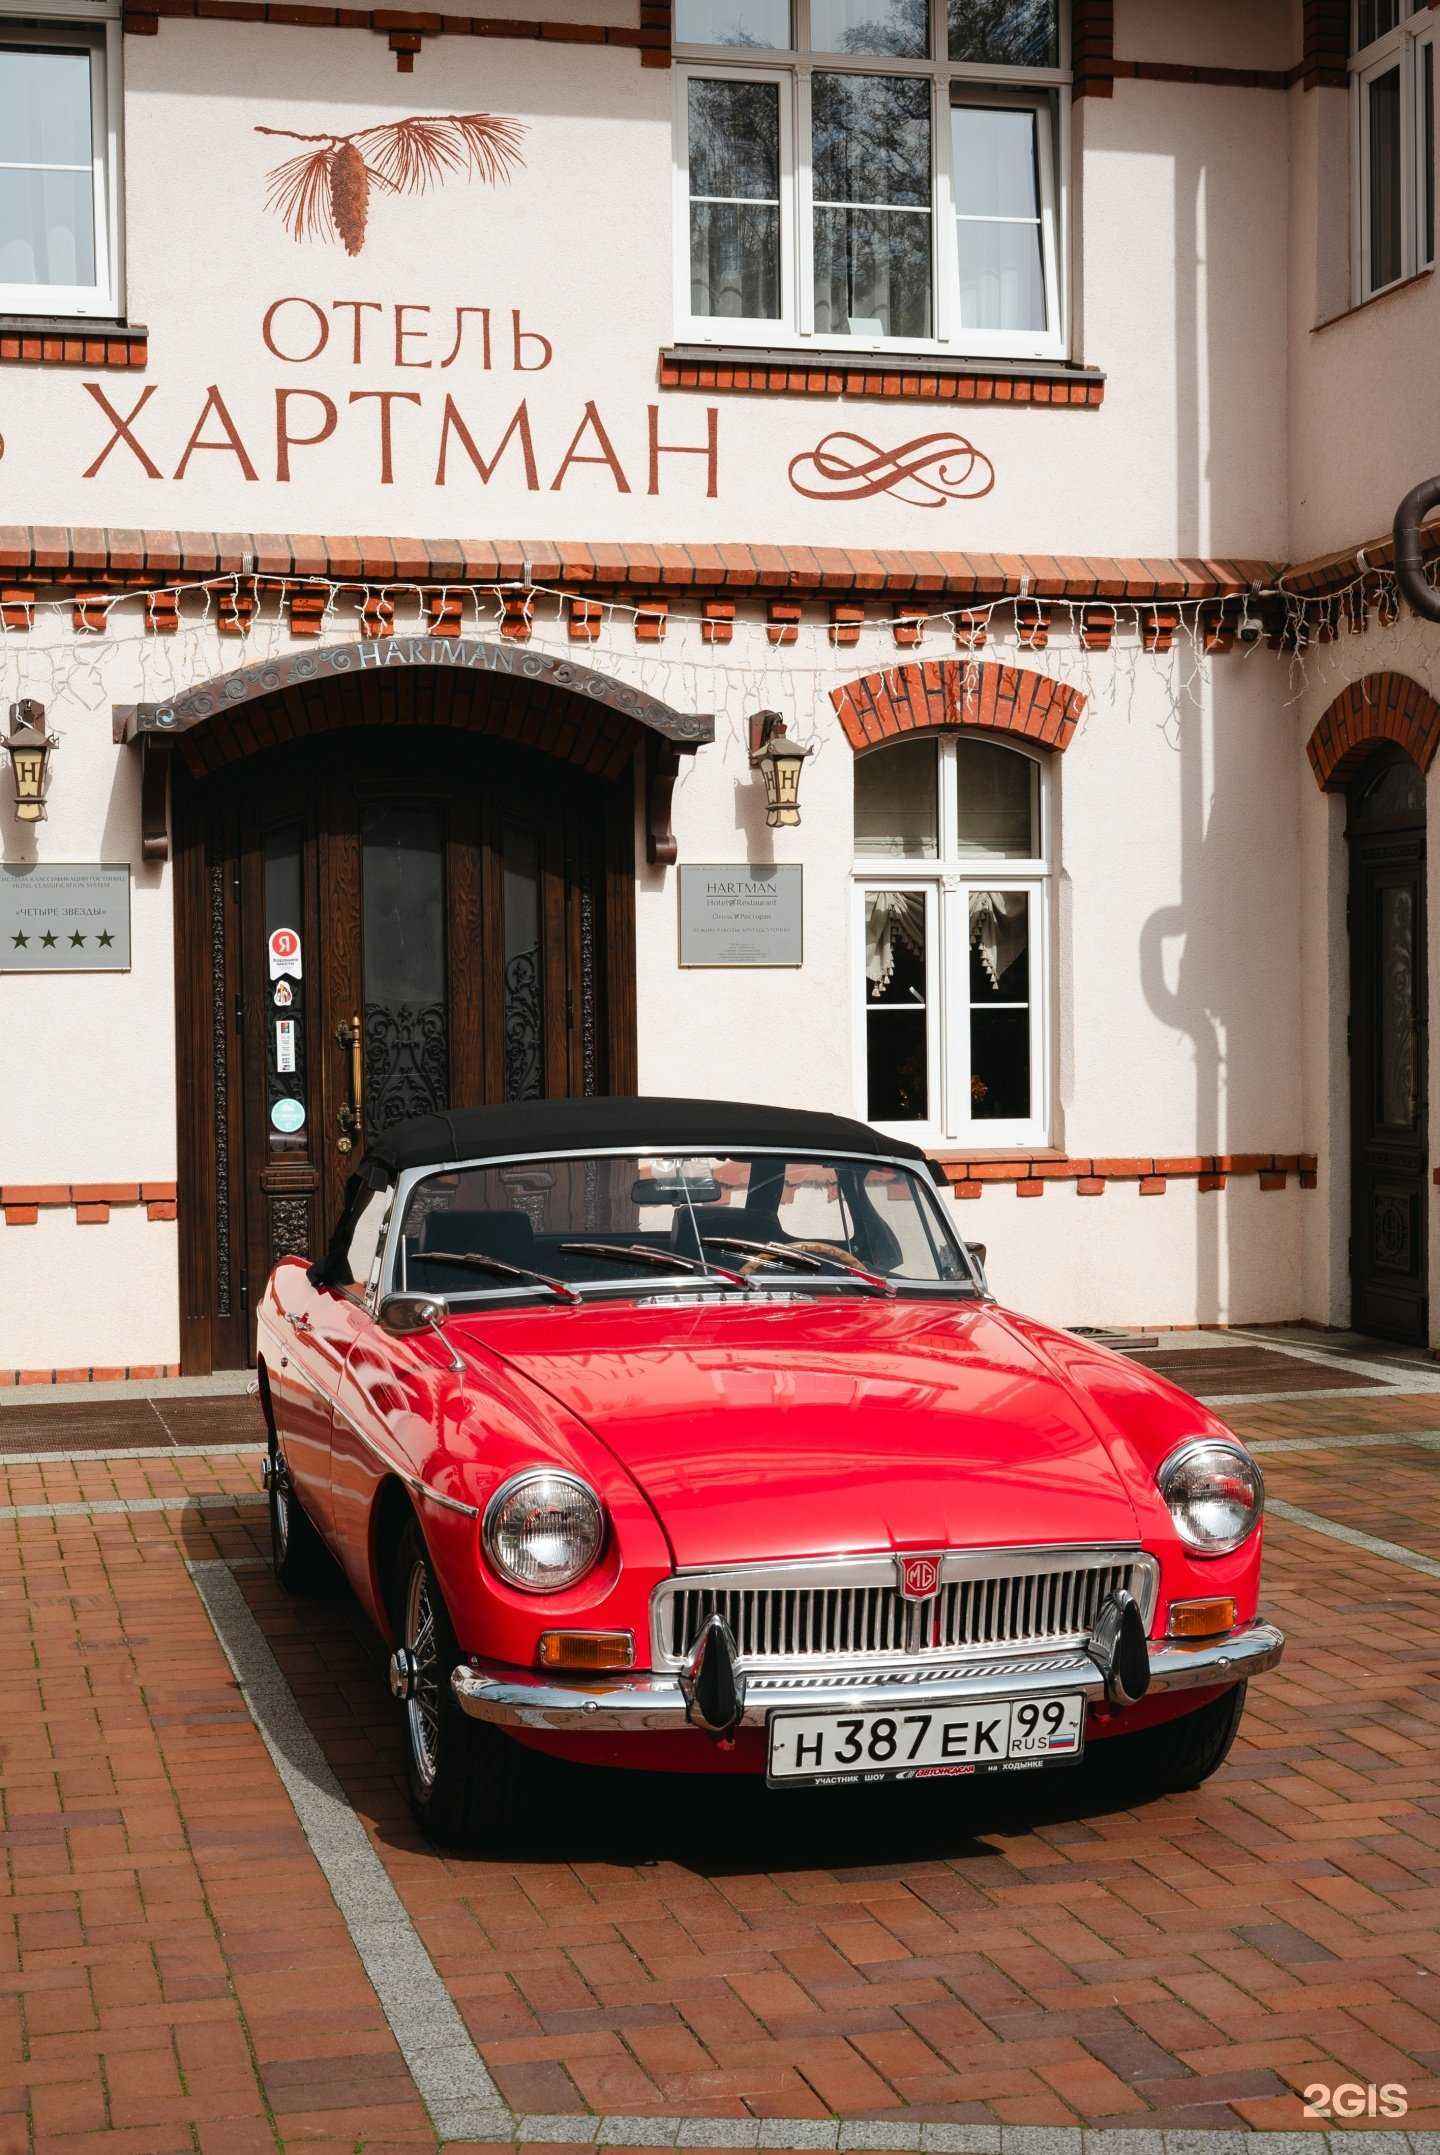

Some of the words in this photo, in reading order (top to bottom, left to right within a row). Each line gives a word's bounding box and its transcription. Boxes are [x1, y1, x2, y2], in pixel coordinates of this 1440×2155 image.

[262, 297, 553, 371] ОТЕЛЬ
[82, 382, 719, 498] ХАРТМАН
[356, 639, 514, 672] HARTMAN
[17, 760, 40, 782] H
[780, 769, 799, 789] H
[707, 882, 777, 894] HARTMAN
[279, 936, 290, 953] Я
[910, 1564, 933, 1588] MG
[1017, 1701, 1065, 1738] 99
[1011, 1736, 1047, 1751] RUS
[815, 1775, 859, 1785] УЧАСТНИК
[864, 1773, 885, 1782] ШОУ
[1002, 1760, 1044, 1770] ХОДЫНКЕ
